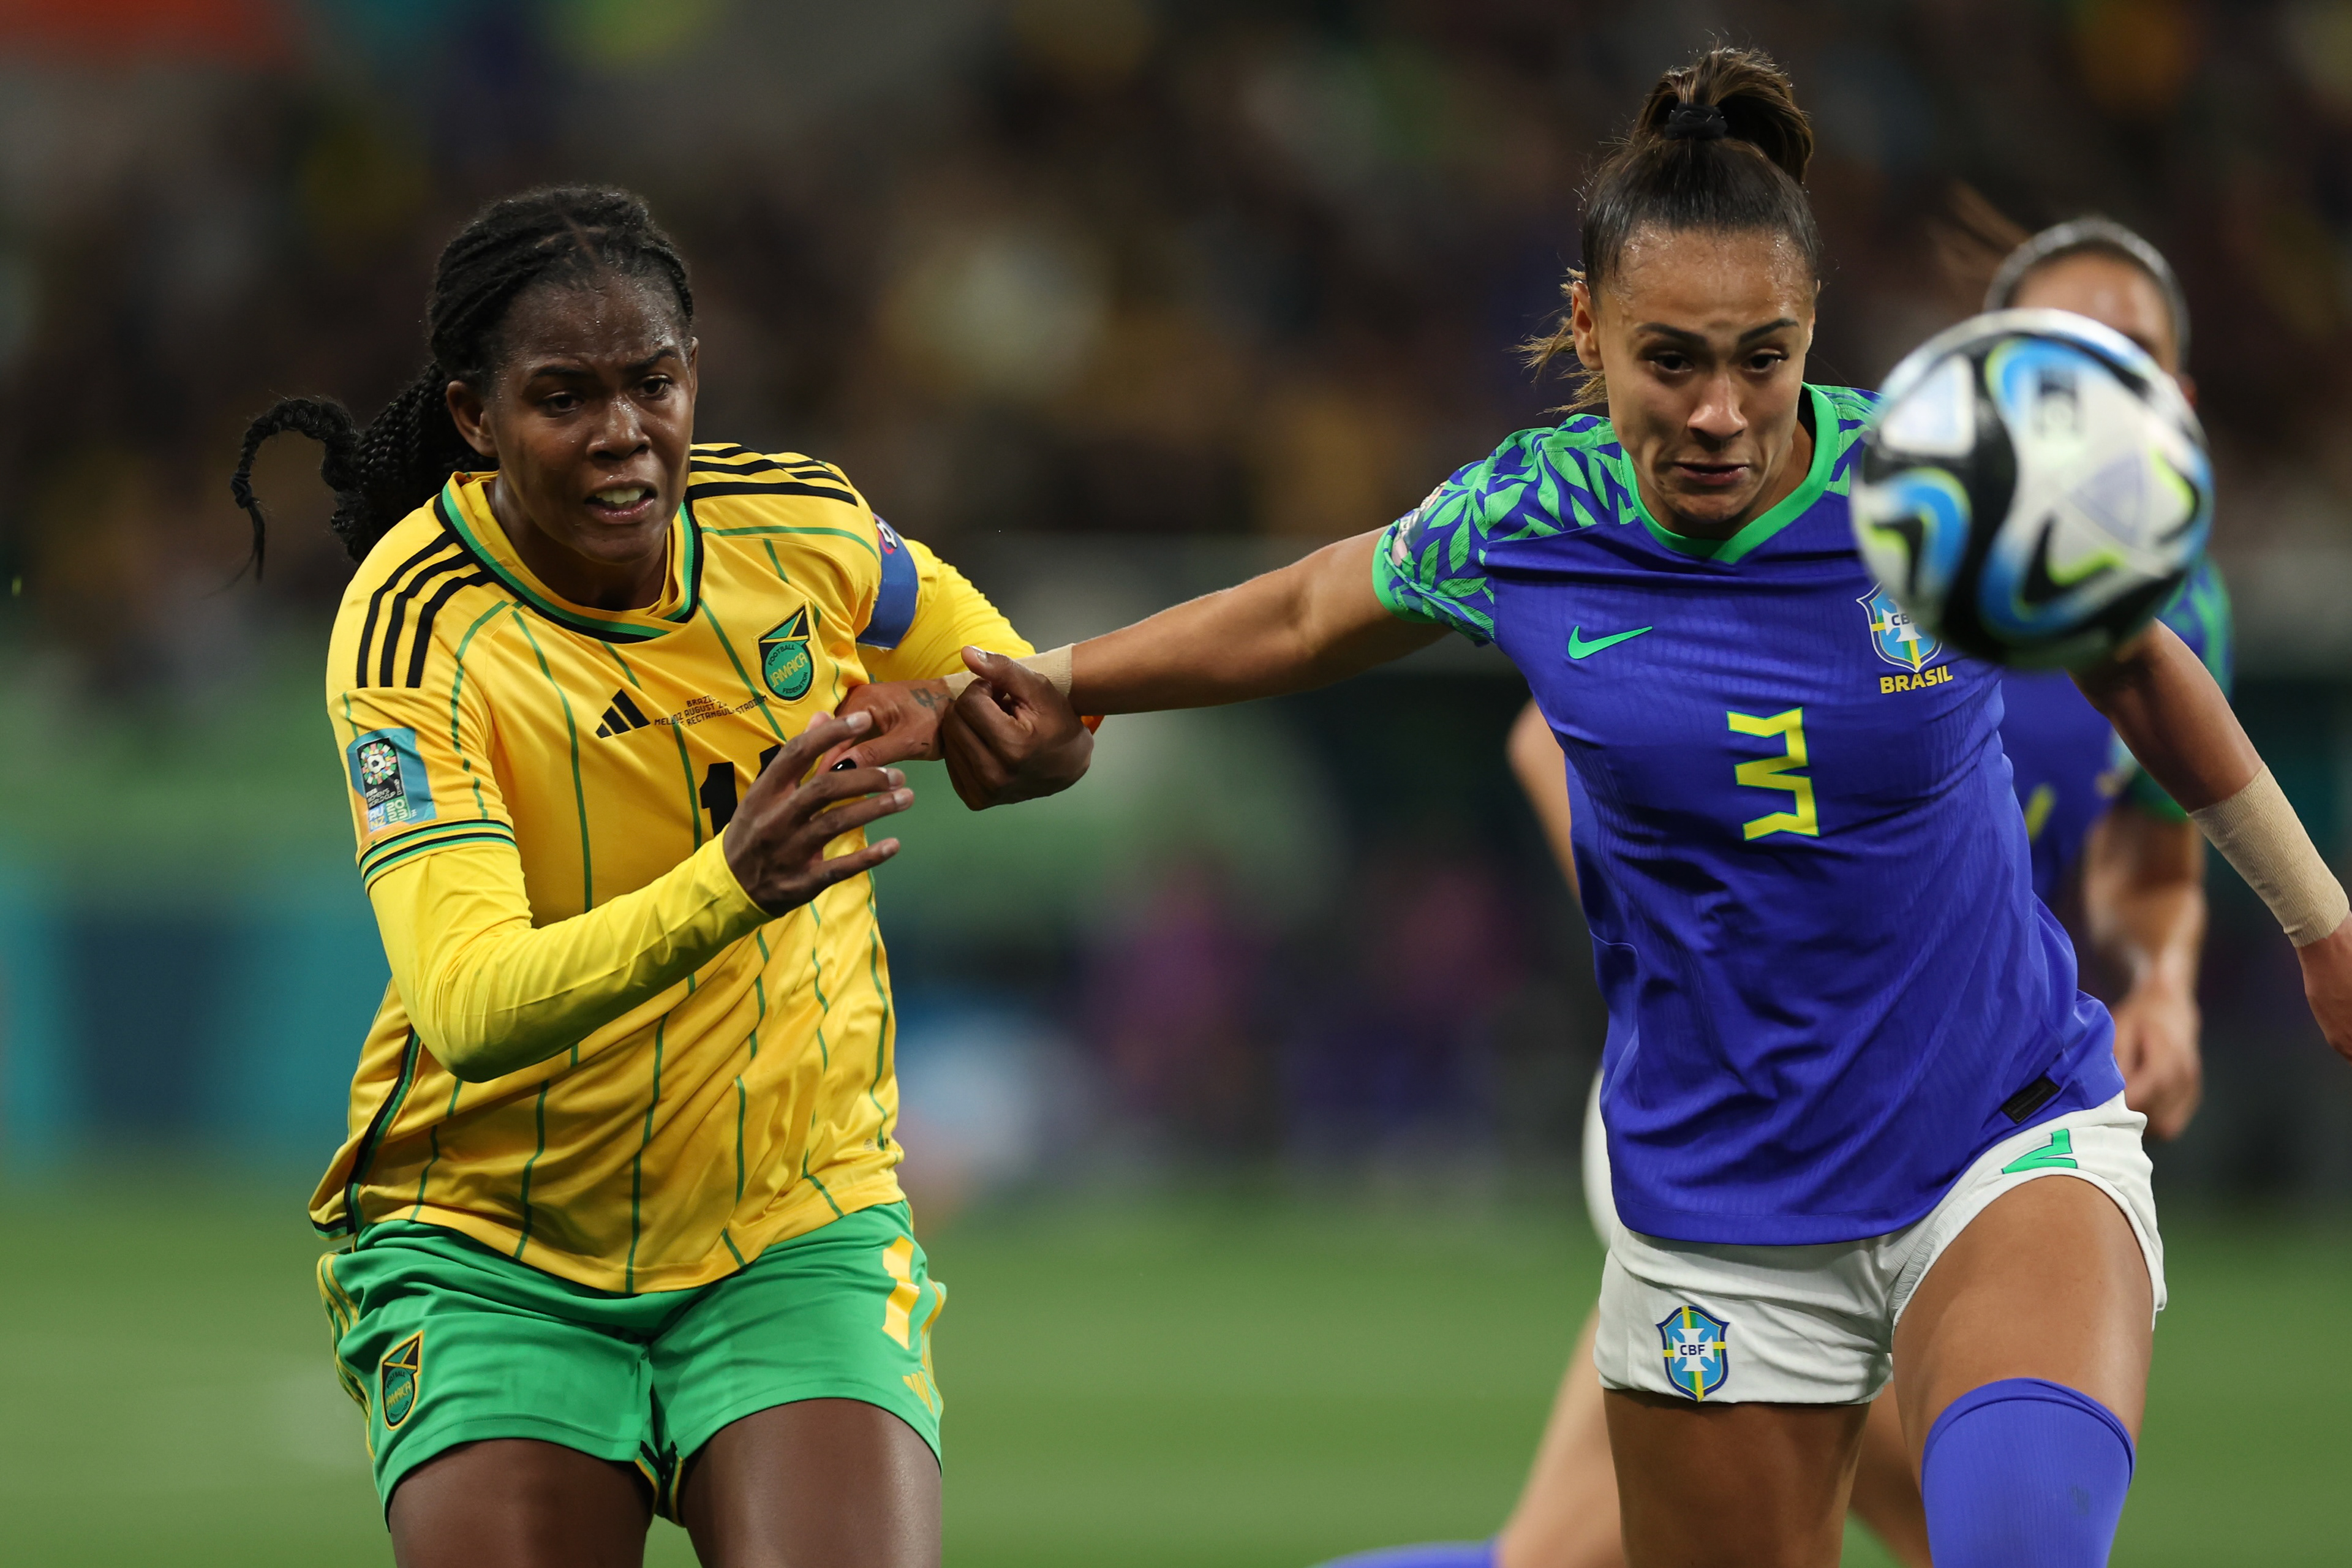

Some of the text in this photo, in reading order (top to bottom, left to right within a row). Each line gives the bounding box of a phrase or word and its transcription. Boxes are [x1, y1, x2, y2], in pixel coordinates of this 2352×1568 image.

[1891, 614, 1912, 625] CB
[768, 644, 795, 666] FOOTBALL
[770, 652, 808, 687] JAMAICA
[783, 672, 808, 693] FEDERATION
[1880, 665, 1953, 694] BRASIL
[684, 703, 714, 717] AUGUST
[687, 708, 735, 726] RECTANGUL
[1726, 706, 1820, 842] 3
[386, 799, 405, 813] 20
[388, 809, 409, 823] 23
[1680, 1344, 1705, 1355] CBF
